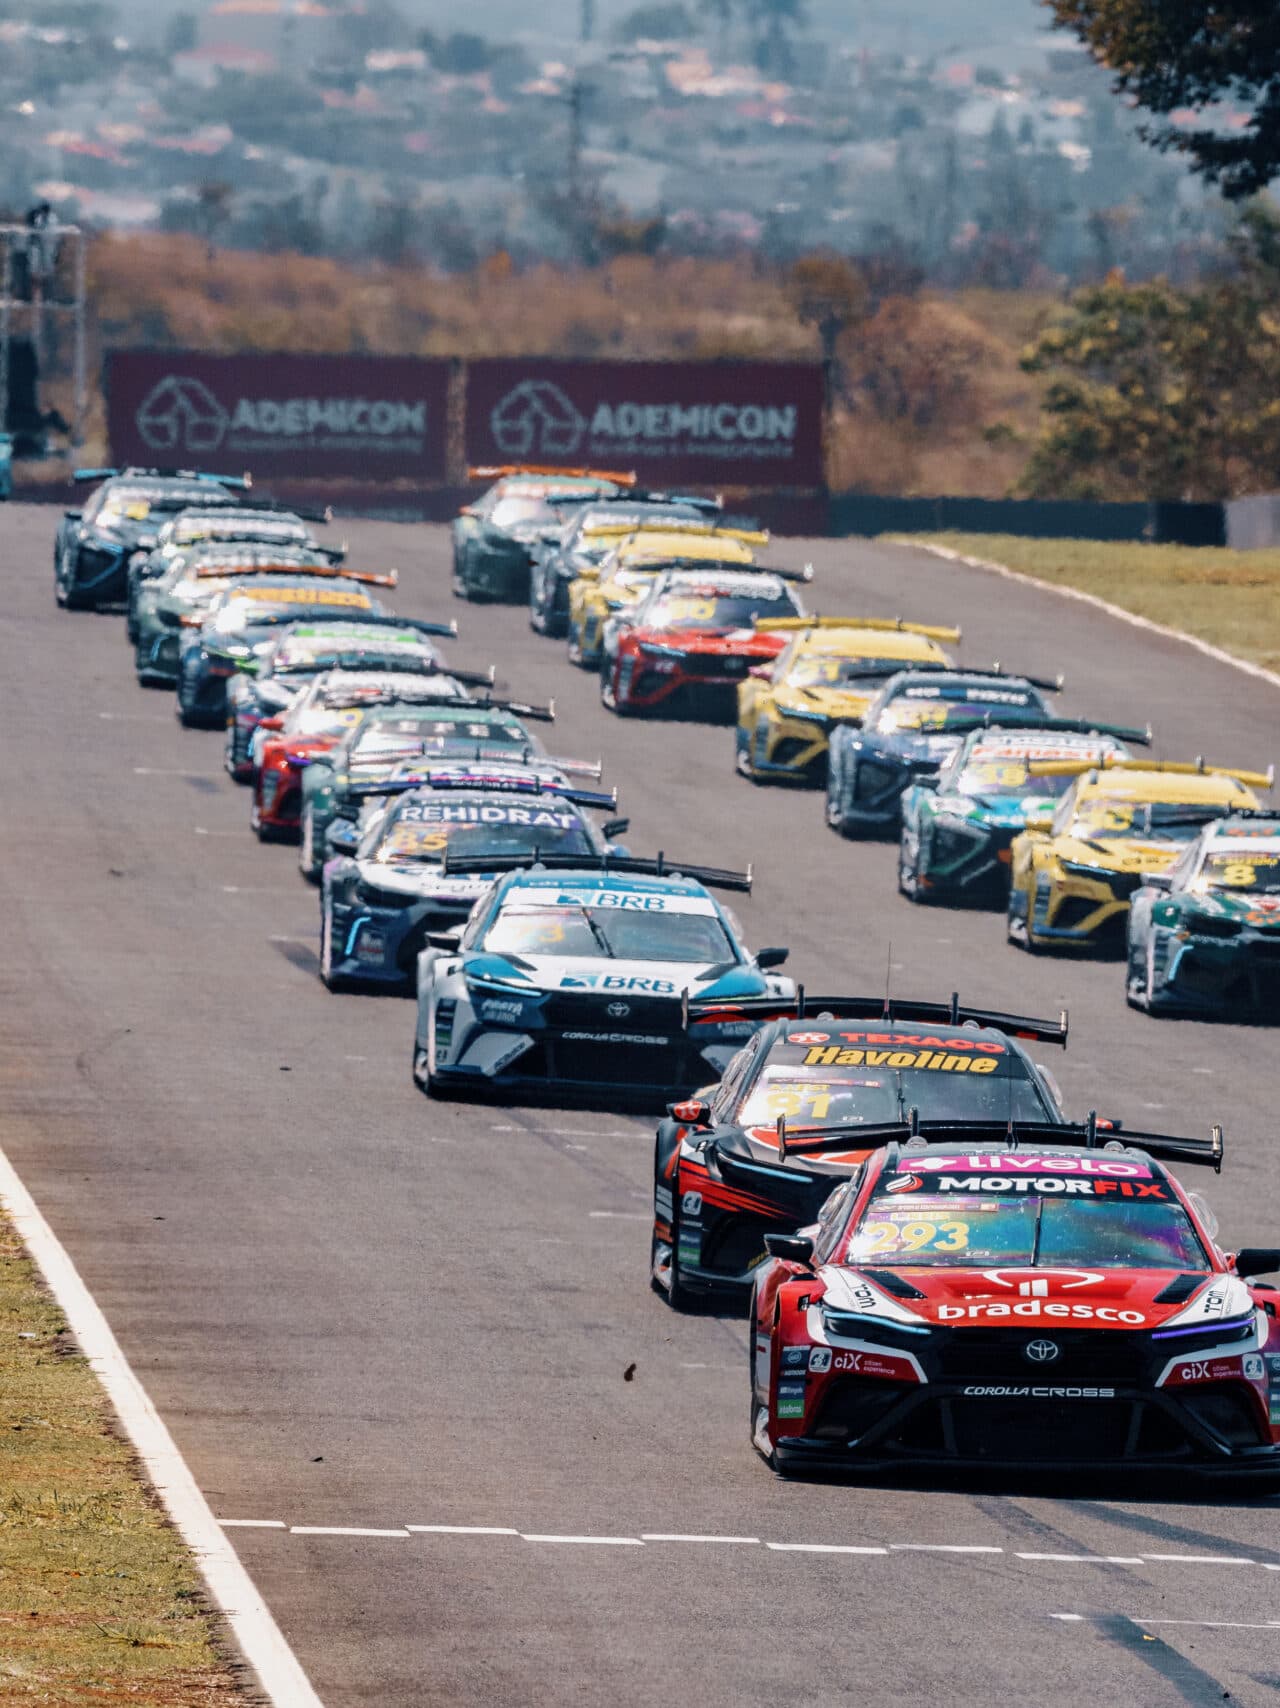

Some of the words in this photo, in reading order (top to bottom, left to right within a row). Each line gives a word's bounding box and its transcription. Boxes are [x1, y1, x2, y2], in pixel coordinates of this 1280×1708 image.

[231, 398, 427, 435] ADEMICON
[590, 402, 797, 439] ADEMICON
[1223, 865, 1257, 886] 8
[597, 893, 665, 911] BRB
[603, 975, 674, 993] BRB
[840, 1032, 1006, 1053] TEXACO
[804, 1046, 999, 1073] Havoline
[938, 1176, 1169, 1198] MOTORFIX
[864, 1221, 970, 1253] 293
[937, 1300, 1146, 1324] bradesco
[963, 1386, 1030, 1396] COROLLA
[1032, 1387, 1115, 1397] CROSS
